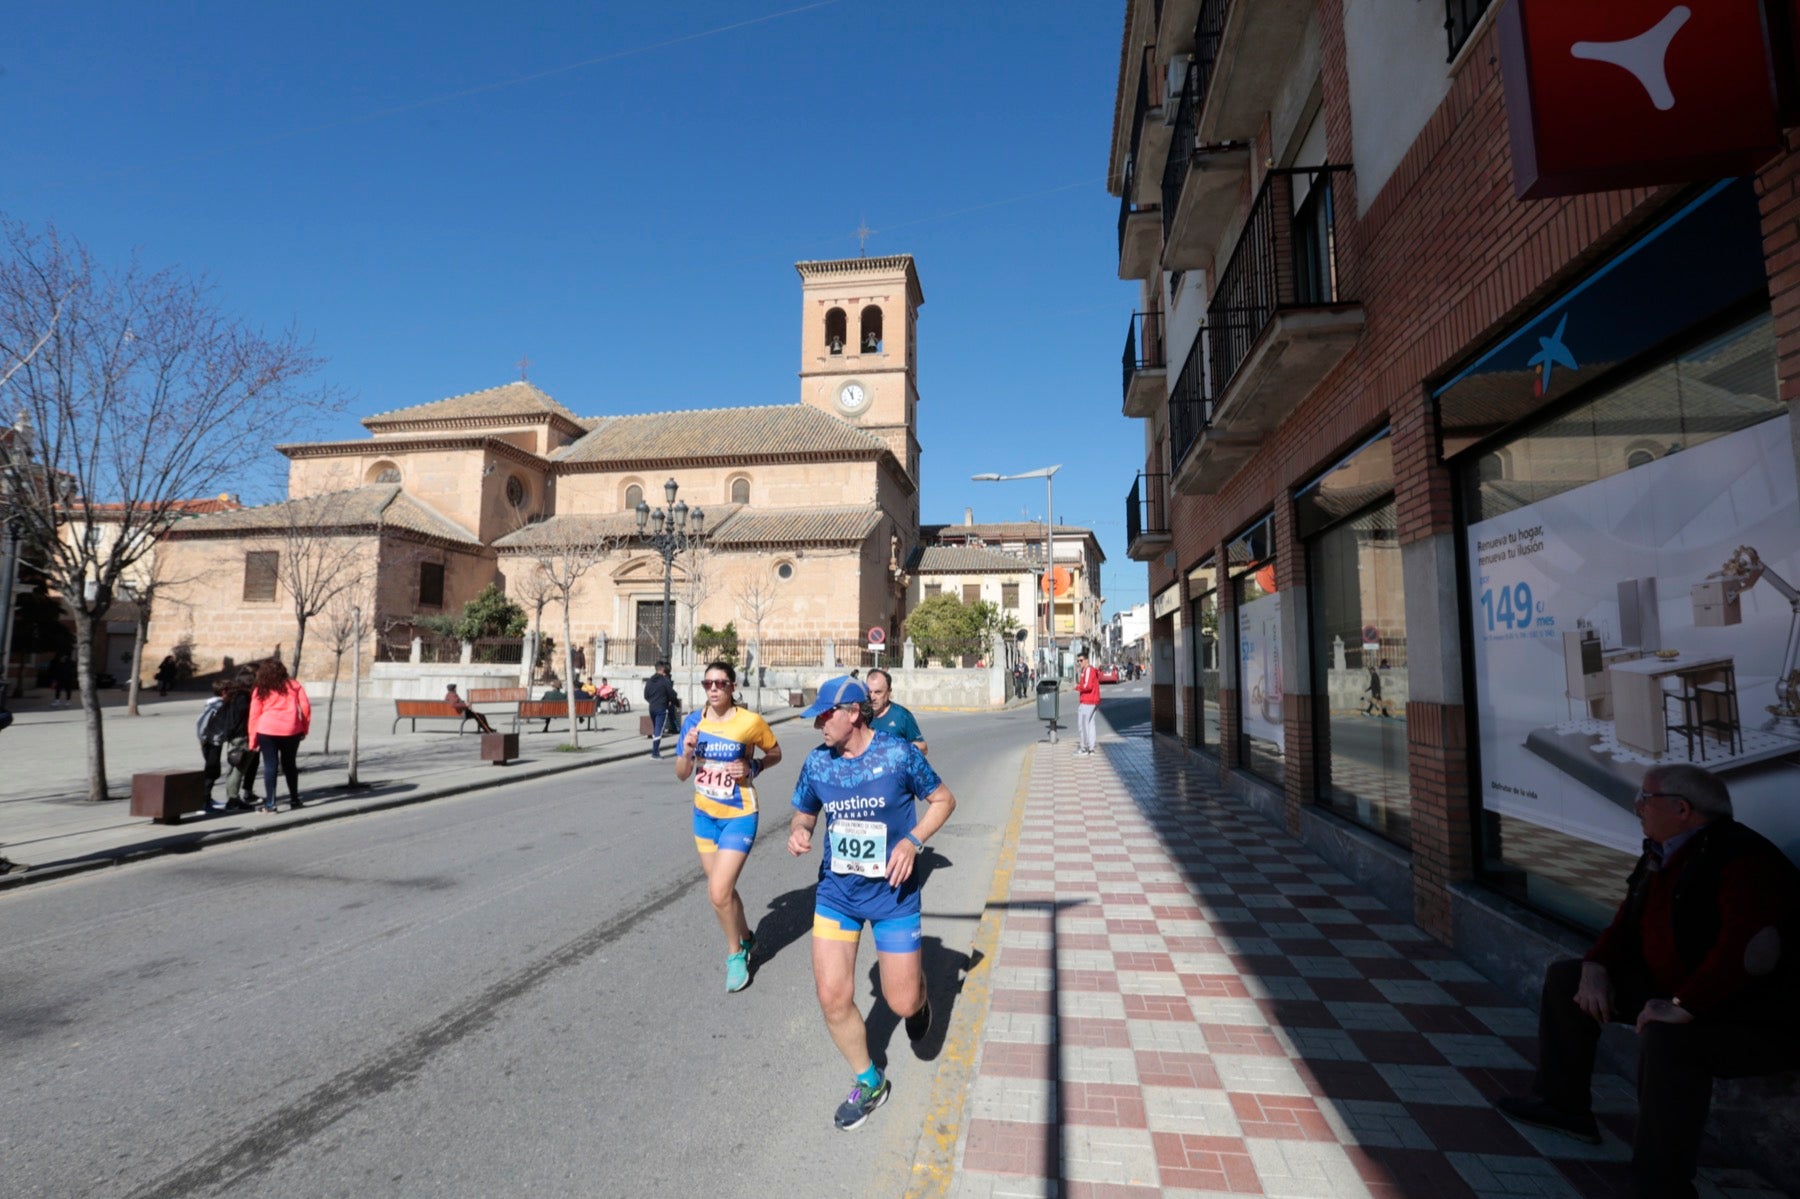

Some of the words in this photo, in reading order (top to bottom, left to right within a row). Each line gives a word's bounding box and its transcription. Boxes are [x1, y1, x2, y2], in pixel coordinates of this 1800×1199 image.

[1478, 536, 1507, 552] Renueva
[1509, 533, 1517, 543] tu
[1478, 551, 1506, 567] renueva
[1508, 550, 1516, 559] tu
[1480, 581, 1534, 632] 149
[1537, 616, 1555, 627] mes
[696, 769, 733, 788] 2118
[837, 837, 876, 859] 492
